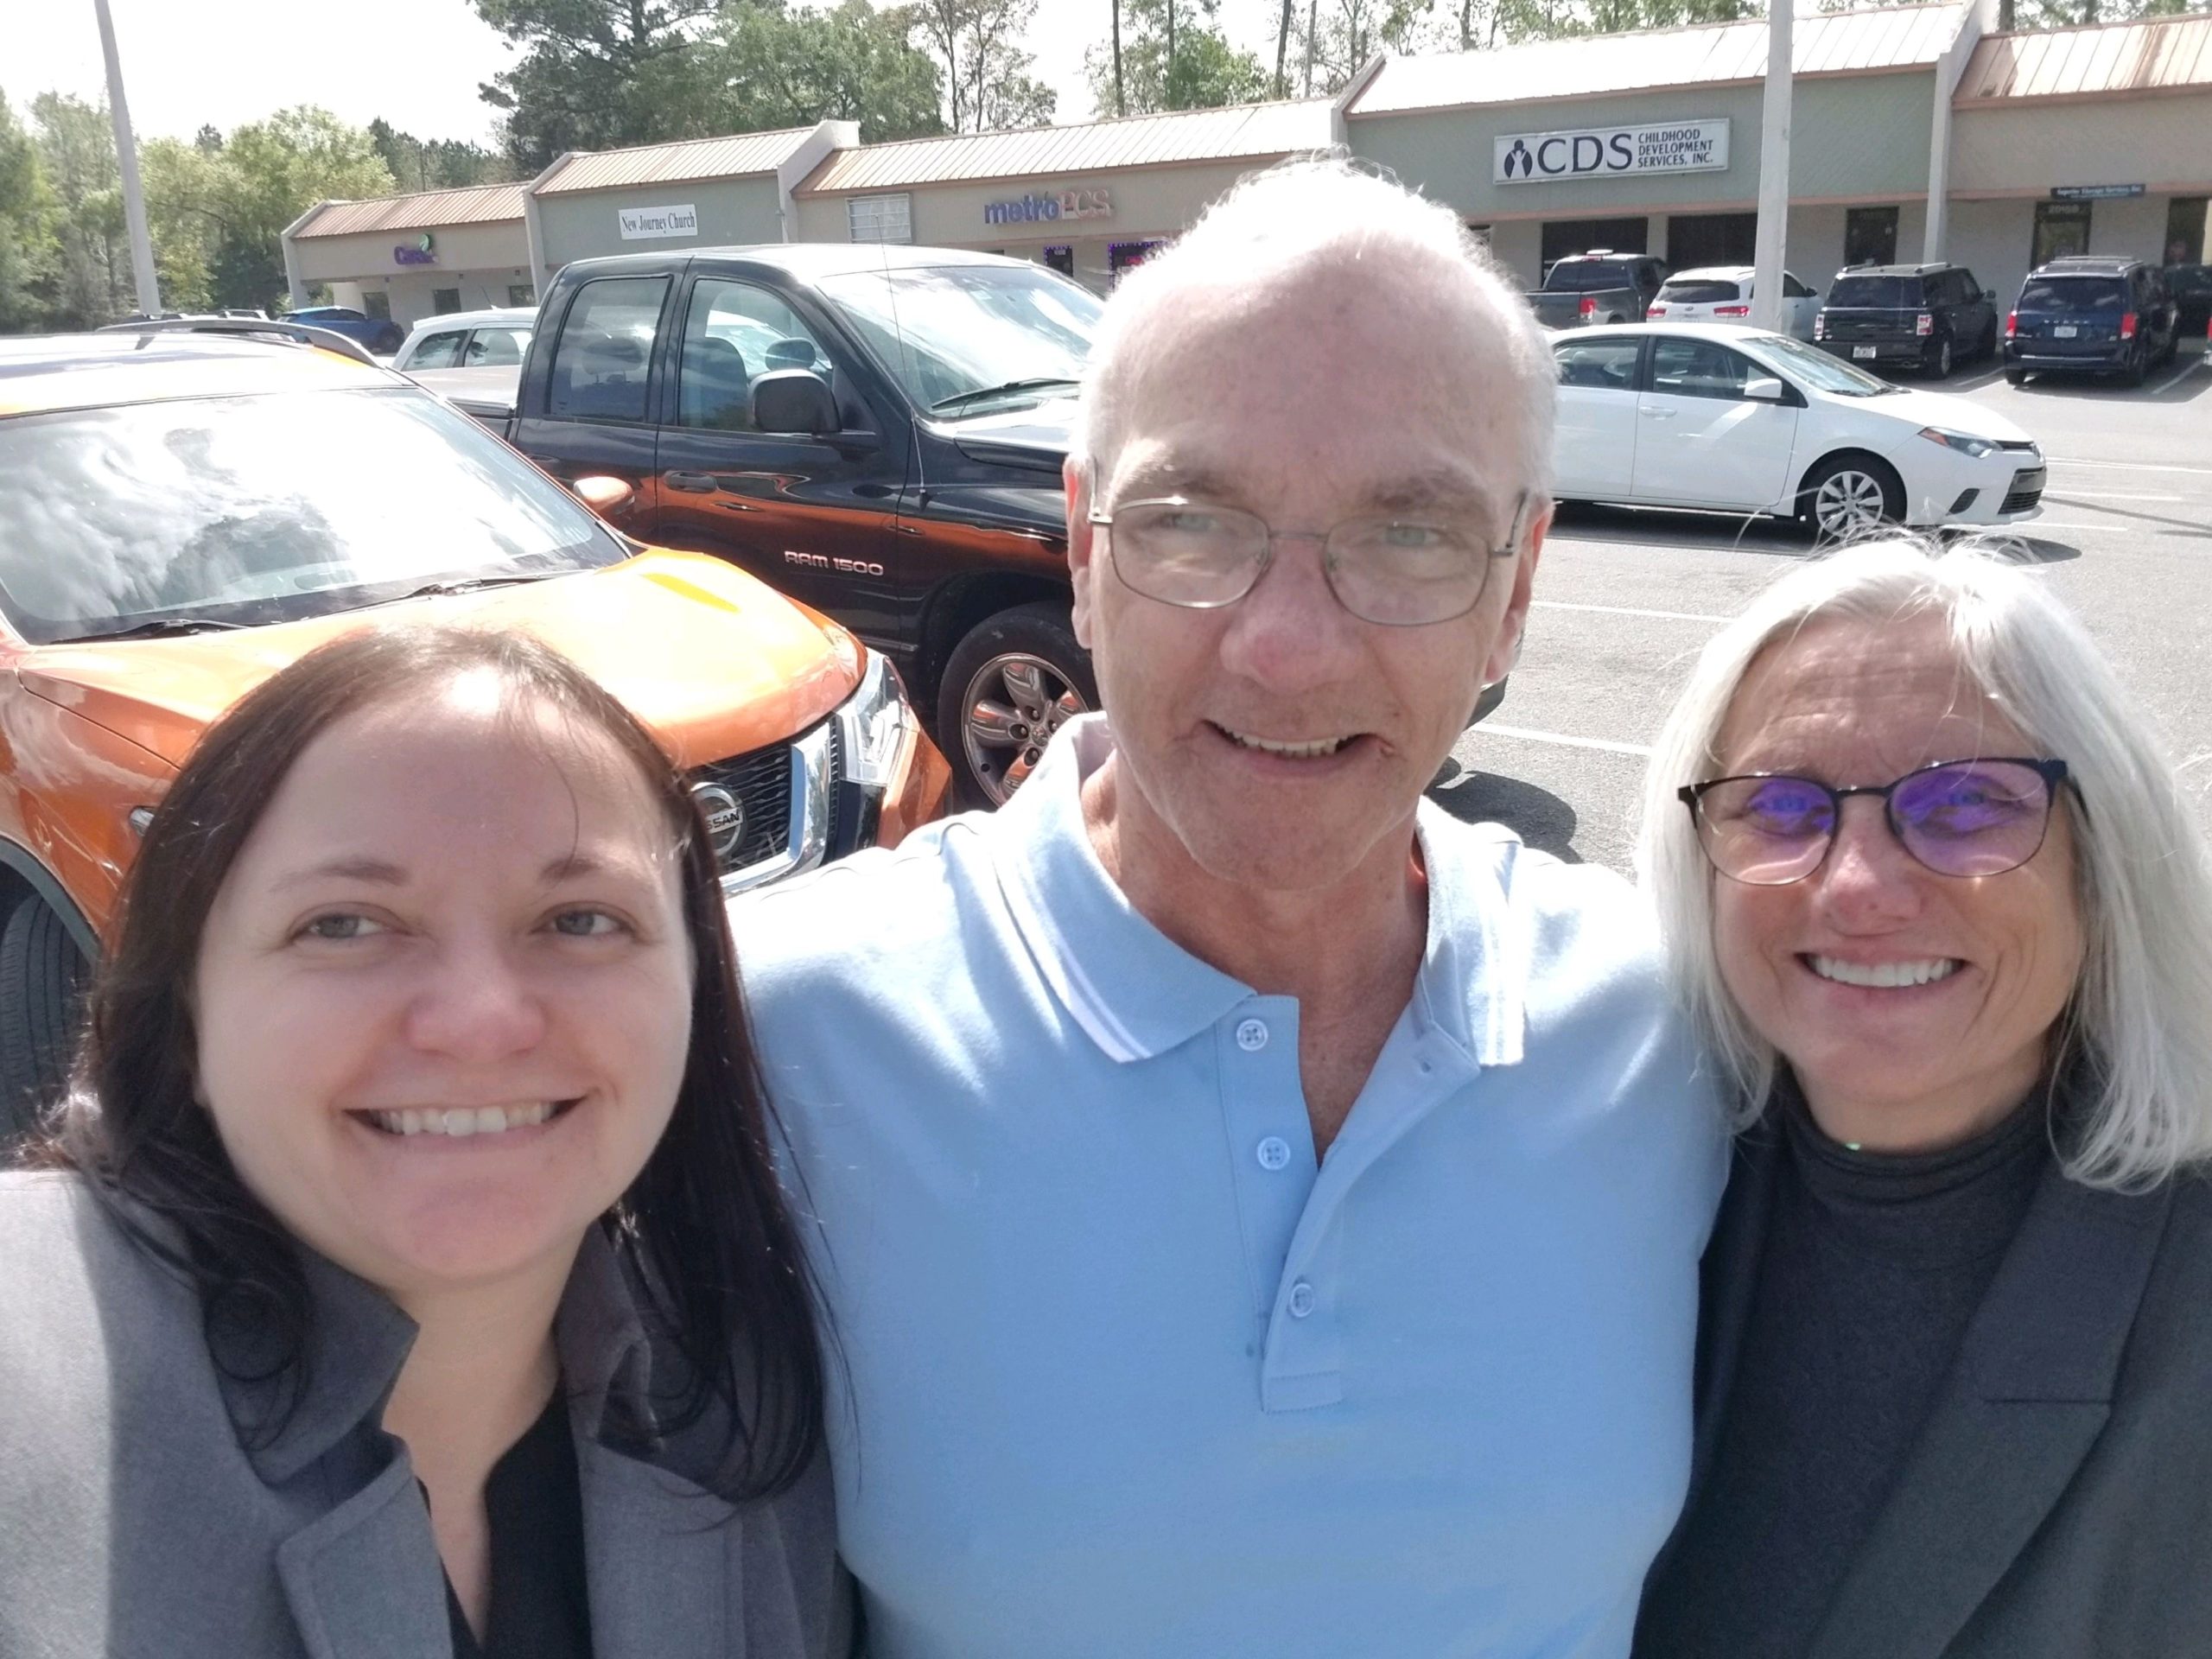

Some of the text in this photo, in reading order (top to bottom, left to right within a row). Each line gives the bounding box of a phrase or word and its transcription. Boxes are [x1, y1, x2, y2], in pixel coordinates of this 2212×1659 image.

[1638, 129, 1700, 144] CHILDHOOD
[1537, 133, 1632, 174] CDS
[1638, 140, 1713, 156] DEVELOPMENT
[1637, 152, 1713, 168] SERVICES, INC.
[984, 188, 1112, 225] metroPCS
[622, 211, 696, 233] New Journey Church
[784, 550, 884, 576] RAM 1500
[704, 809, 740, 830] SSAN
